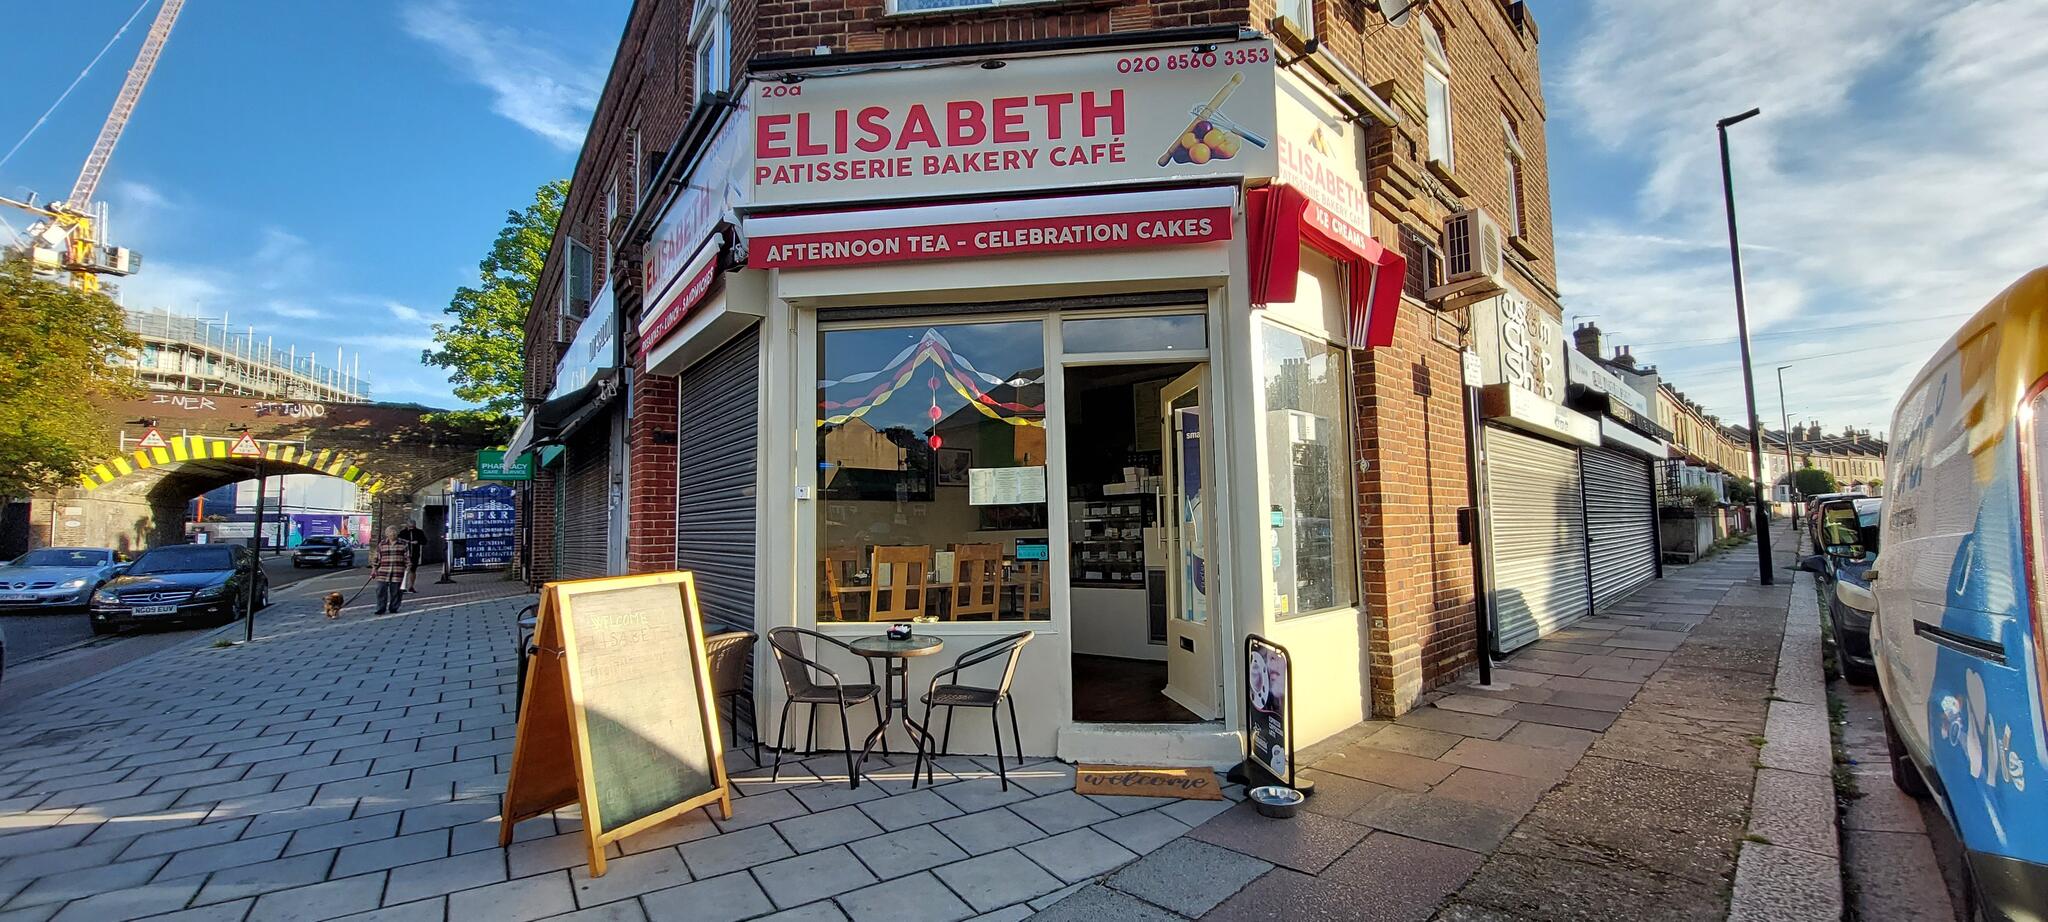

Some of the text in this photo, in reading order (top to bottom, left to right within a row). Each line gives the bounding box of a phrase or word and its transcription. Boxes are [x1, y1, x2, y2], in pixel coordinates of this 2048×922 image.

[1117, 47, 1269, 73] 020 8560 3353
[762, 82, 801, 98] 20a
[756, 89, 1126, 159] ELISABETH
[755, 137, 1126, 186] PATISSERIE BAKERY CAFÉ
[1278, 134, 1365, 216] ELISABETH
[646, 180, 711, 293] ELISABETH
[767, 237, 900, 263] AFTERNOON
[908, 235, 950, 253] TEA
[974, 223, 1128, 250] CELEBRATION
[1138, 217, 1213, 239] CAKES
[1315, 206, 1366, 250] ICE CREAMS
[1084, 771, 1210, 790] welcome
